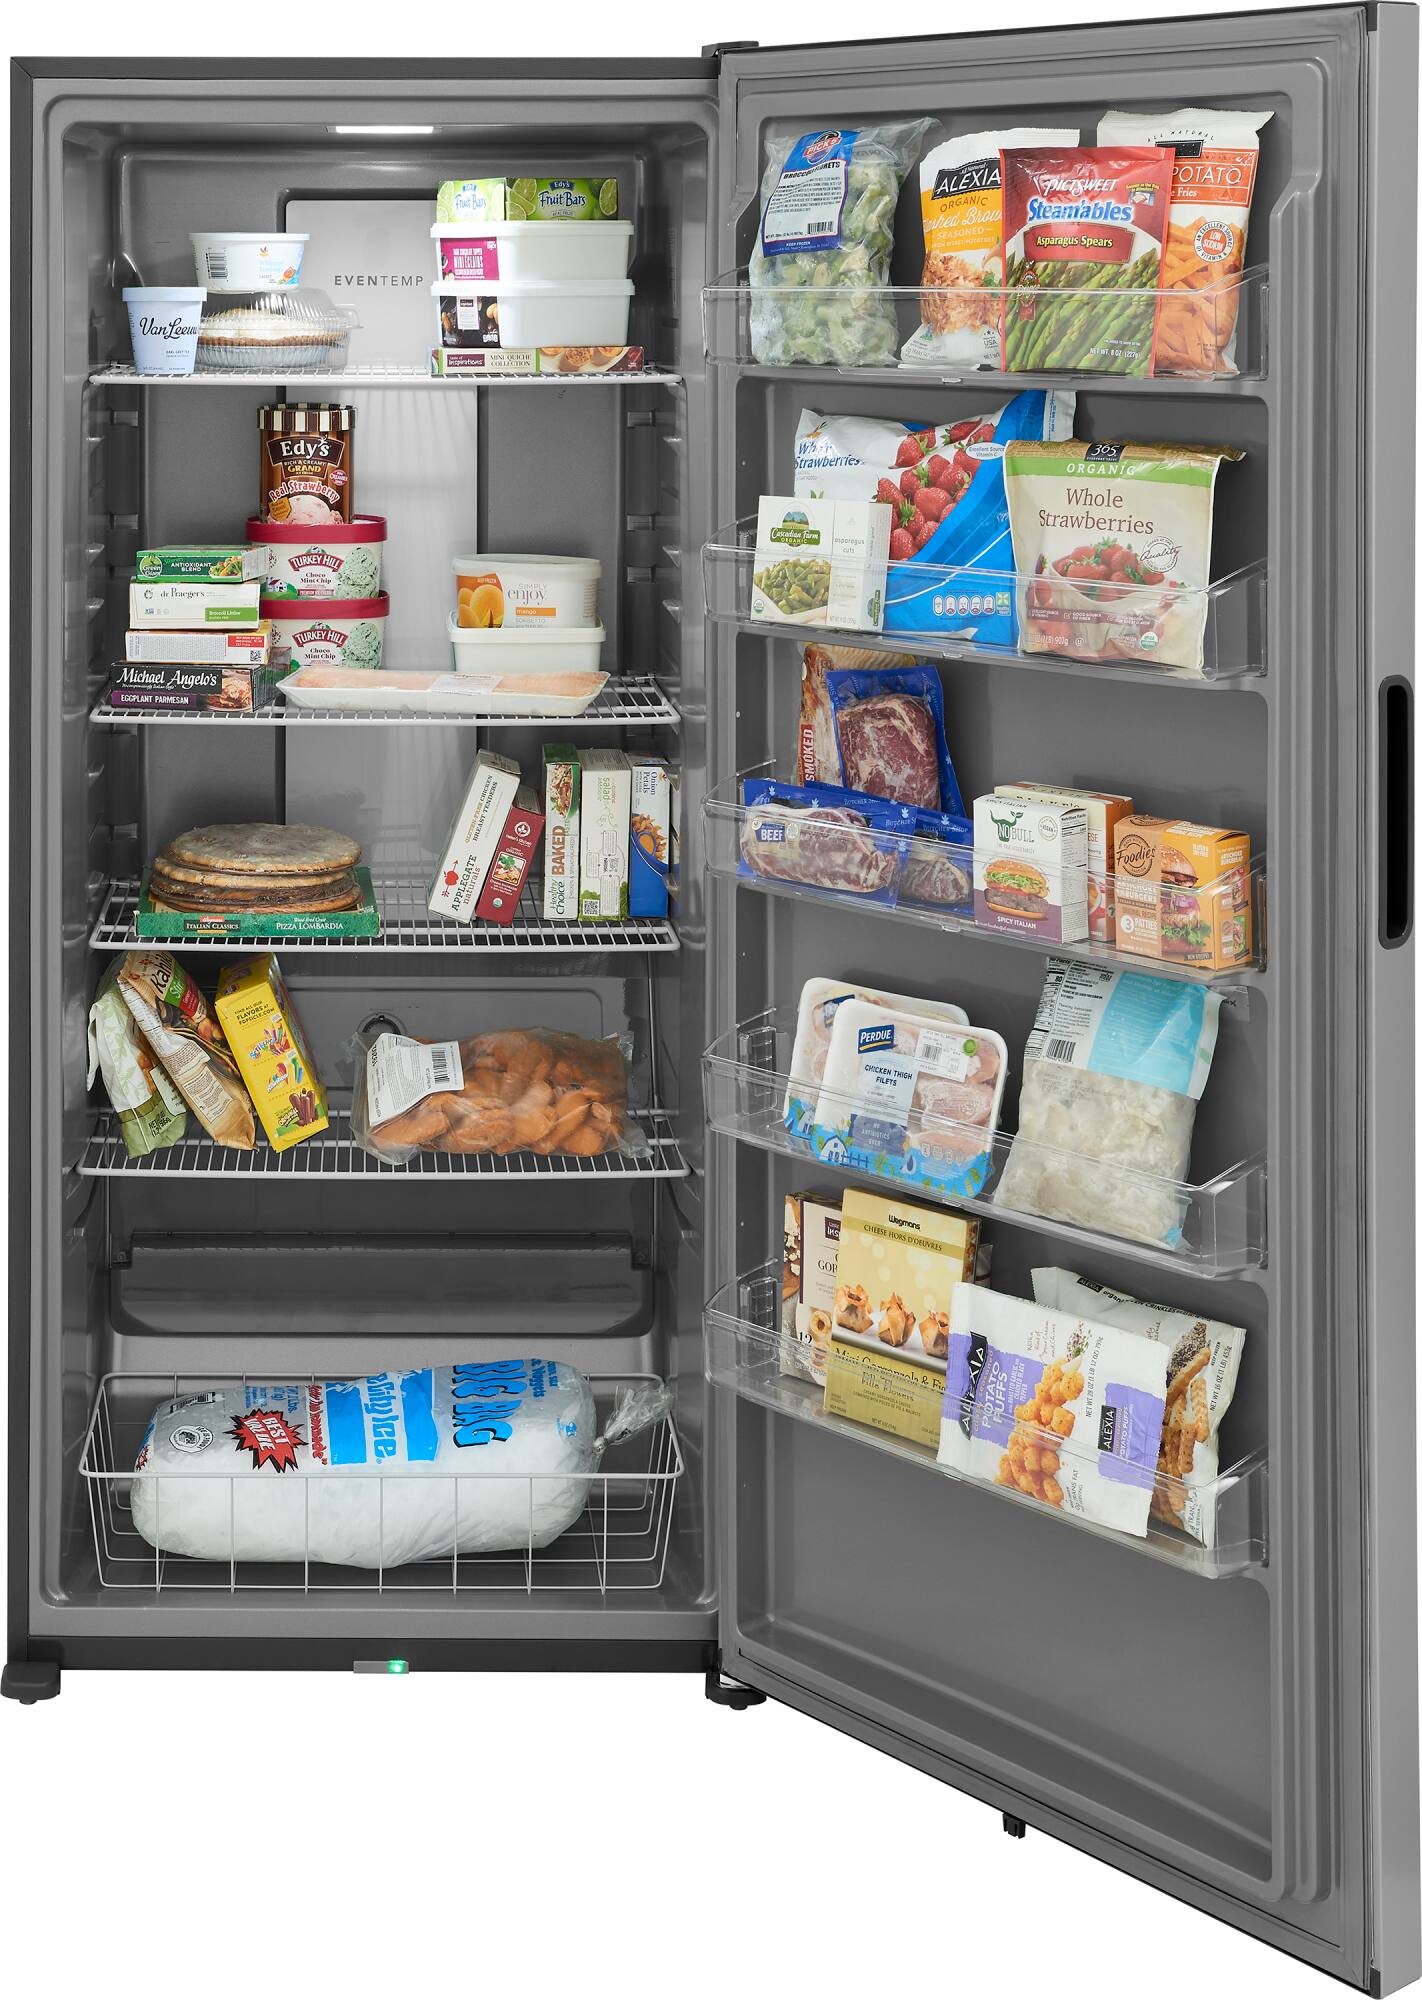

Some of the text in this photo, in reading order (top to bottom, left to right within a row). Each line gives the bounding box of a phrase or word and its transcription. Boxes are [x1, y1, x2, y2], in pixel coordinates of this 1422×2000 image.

[1171, 130, 1214, 141] NATURAL
[936, 168, 1002, 194] ALEXIA
[1040, 179, 1119, 196] PICTSWEET
[539, 191, 586, 208] Fruit Bars
[1177, 187, 1198, 197] Fries
[940, 196, 989, 213] ORGANIC
[1028, 198, 1134, 222] Steam'ables
[937, 227, 985, 239] SEASONED
[1037, 236, 1113, 247] Asparagus Spears
[1210, 230, 1222, 240] LOW
[334, 275, 423, 286] EVENTEMP
[139, 317, 168, 336] Van
[280, 437, 330, 459] Edy's
[1091, 444, 1120, 457] 365
[287, 465, 321, 473] GRAND
[794, 453, 861, 471] Strawberries
[1066, 463, 1137, 476] ORGANIC
[268, 480, 341, 504] Real Strawberry
[1066, 488, 1123, 509] Whole
[1038, 509, 1154, 534] Strawberries
[771, 528, 819, 540] Cascadian Farm
[834, 538, 865, 546] asparagus
[290, 554, 340, 569] TURKEY HILL
[1139, 546, 1183, 562] Quality
[507, 589, 546, 606] enjoy
[294, 630, 345, 645] TURKEY HILL
[116, 668, 218, 690] Michael Angelo's
[120, 694, 189, 705] EGGPLANT PARMESAN
[805, 728, 815, 782] SMOKED
[603, 777, 611, 801] salad
[650, 771, 658, 796] Onion
[473, 781, 498, 842] BREAST TENDERS
[760, 828, 784, 841] BEEF
[998, 823, 1011, 837] NO
[551, 825, 566, 875] BAKED
[1116, 846, 1156, 867] Foodies
[451, 854, 477, 911] APPLEGATE
[463, 867, 481, 905] naturals
[548, 879, 558, 909] Healthy
[556, 881, 565, 914] Choice
[212, 922, 239, 930] CLASSICS
[276, 922, 344, 930] PIZZA LOMBARDIA
[997, 916, 1037, 929] SPICY ITALIAN
[1125, 918, 1132, 931] 3
[236, 1006, 264, 1021] FLAVORS
[238, 1007, 275, 1025] POPSICLE.COM
[860, 1029, 891, 1044] PERDUE
[864, 1064, 913, 1081] CHICKEN THIGH
[875, 1076, 897, 1087] FILETS
[888, 1213, 921, 1230] Wegmans
[863, 1224, 943, 1251] CHEESE HORS D'OEUVRES
[1078, 1279, 1177, 1313] ALEXIA CRINKLES
[1213, 1340, 1221, 1357] FROZEN
[452, 1359, 528, 1398] BIG
[1087, 1381, 1095, 1390] OZ
[1209, 1345, 1233, 1412] NET WT 16 OZ LB) 453g
[982, 1361, 1000, 1428] POTATO
[992, 1371, 1008, 1423] PUFFS
[1019, 1383, 1028, 1402] PEPPER
[1086, 1389, 1094, 1398] 28
[1085, 1397, 1094, 1407] WT
[1084, 1406, 1094, 1418] NET
[1120, 1405, 1132, 1429] PUFFS
[262, 1417, 290, 1445] BEST
[452, 1400, 523, 1449] BAG
[1101, 1409, 1118, 1449] ALEXIA
[243, 1418, 276, 1451] VALUE
